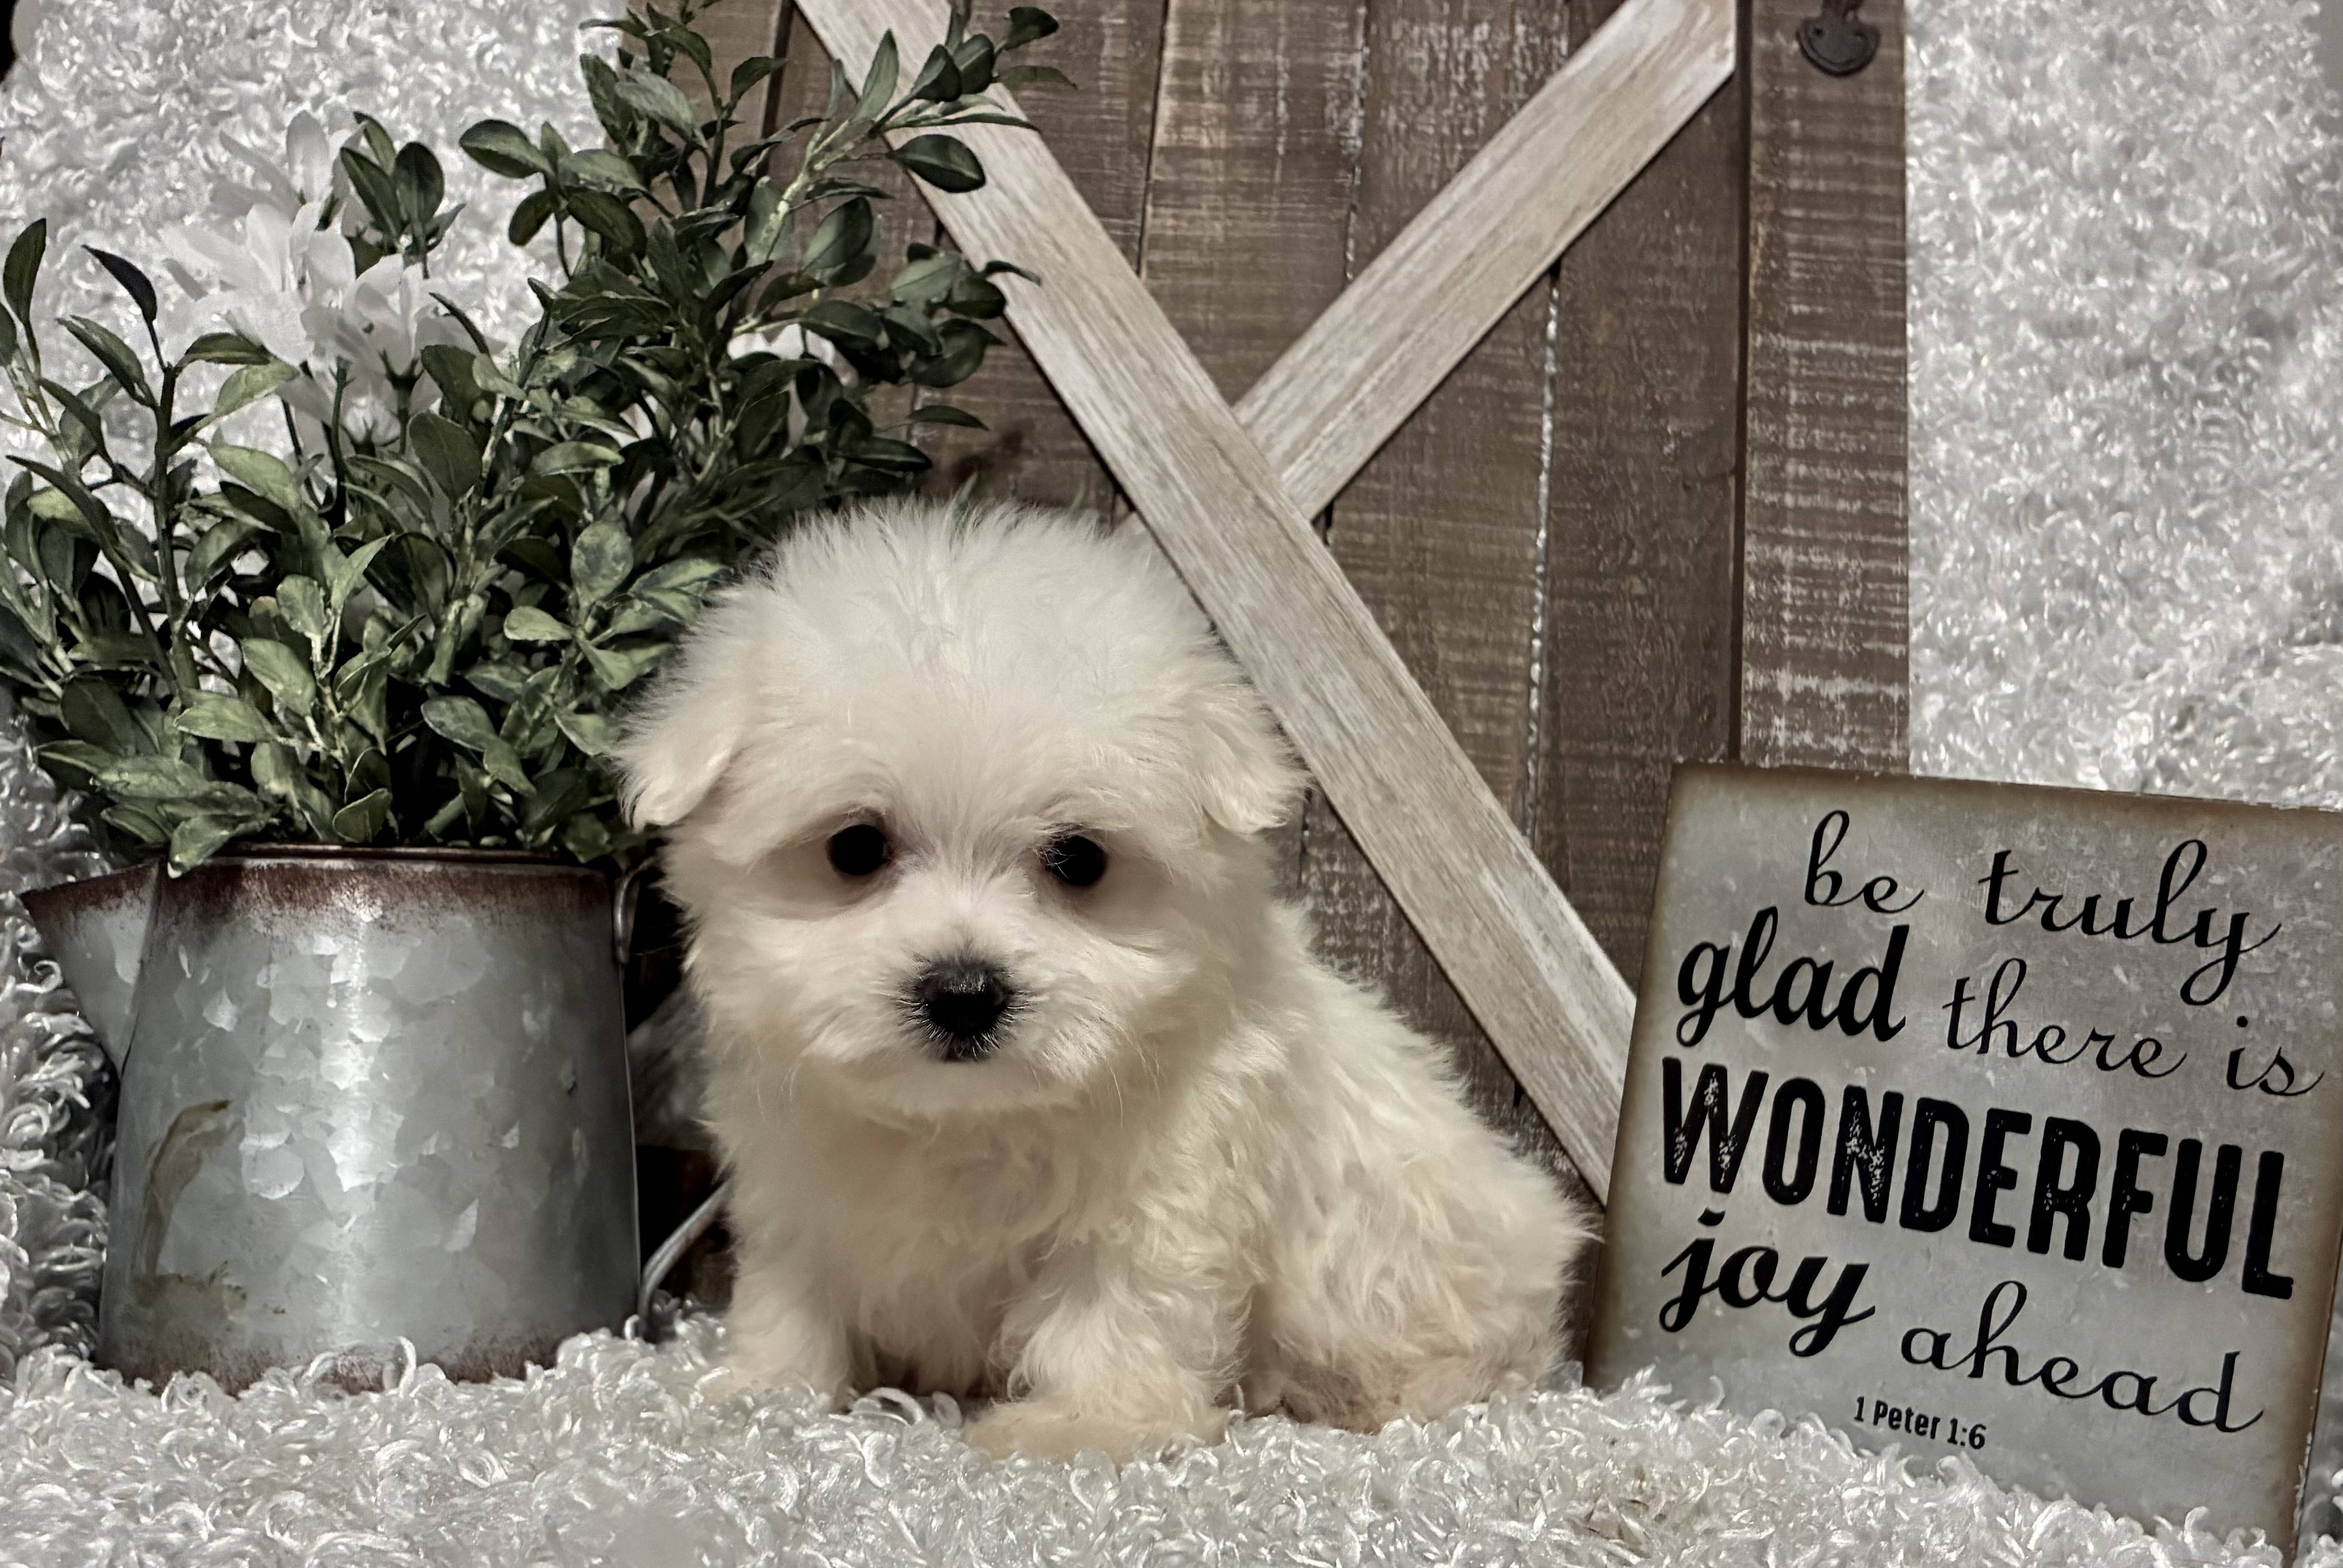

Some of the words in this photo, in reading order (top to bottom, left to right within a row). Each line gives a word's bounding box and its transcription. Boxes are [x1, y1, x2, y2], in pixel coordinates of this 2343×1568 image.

[1675, 905, 1910, 1049] glad
[1941, 957, 2188, 1079] there
[2225, 1015, 2326, 1098] is
[1803, 809, 1925, 915] be
[1977, 838, 2282, 1007] truly
[1661, 1056, 2295, 1301] WONDERFUL
[1658, 1207, 1876, 1358] joy
[1900, 1280, 2265, 1434] ahead
[1853, 1396, 1865, 1423] 1
[1872, 1399, 1941, 1439] Peter
[1947, 1417, 1987, 1451] 1:6
